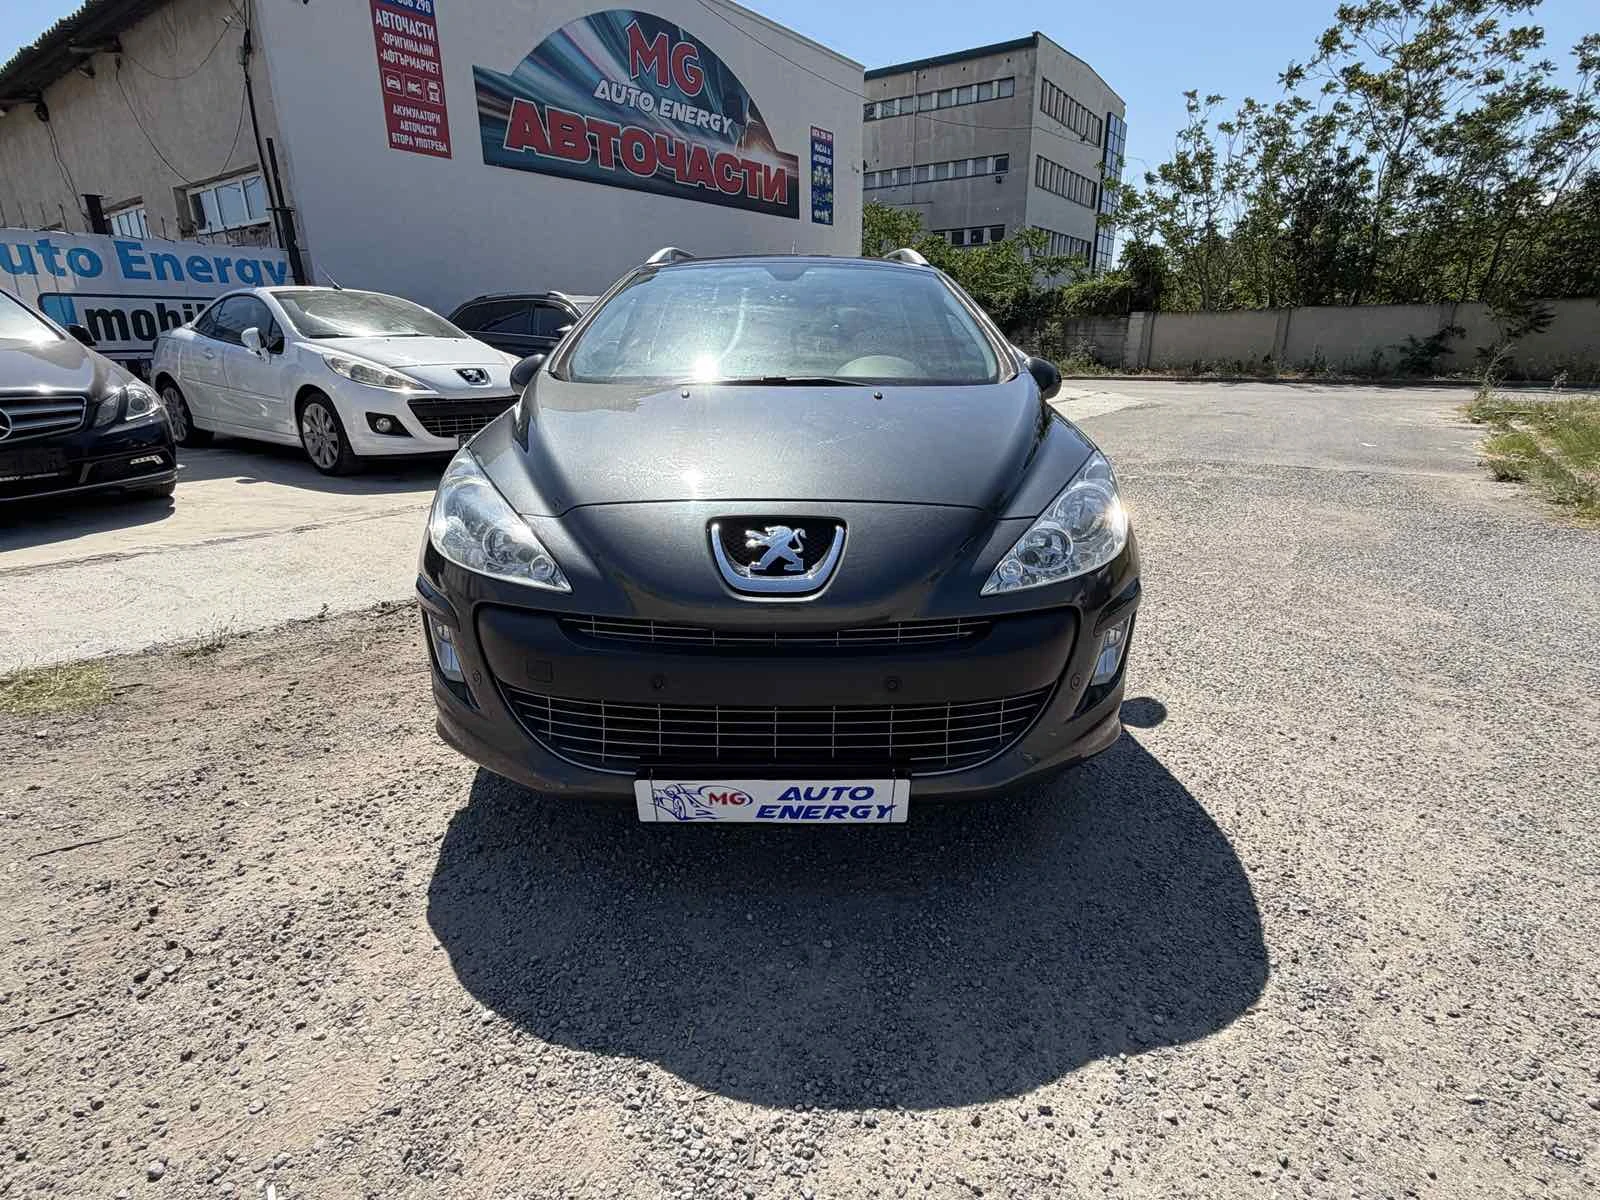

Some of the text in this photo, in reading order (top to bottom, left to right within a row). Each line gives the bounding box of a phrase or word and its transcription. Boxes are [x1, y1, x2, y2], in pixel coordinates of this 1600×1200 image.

[375, 8, 435, 41] АВТОЧАСТИ
[625, 19, 704, 97] MG
[593, 79, 735, 135] AUTO ENERGY
[503, 96, 789, 206] АВТОЧАСТИ
[113, 240, 287, 288] Energy
[708, 792, 746, 805] MG
[755, 804, 897, 820] ENERGY
[777, 786, 875, 801] AUTO
